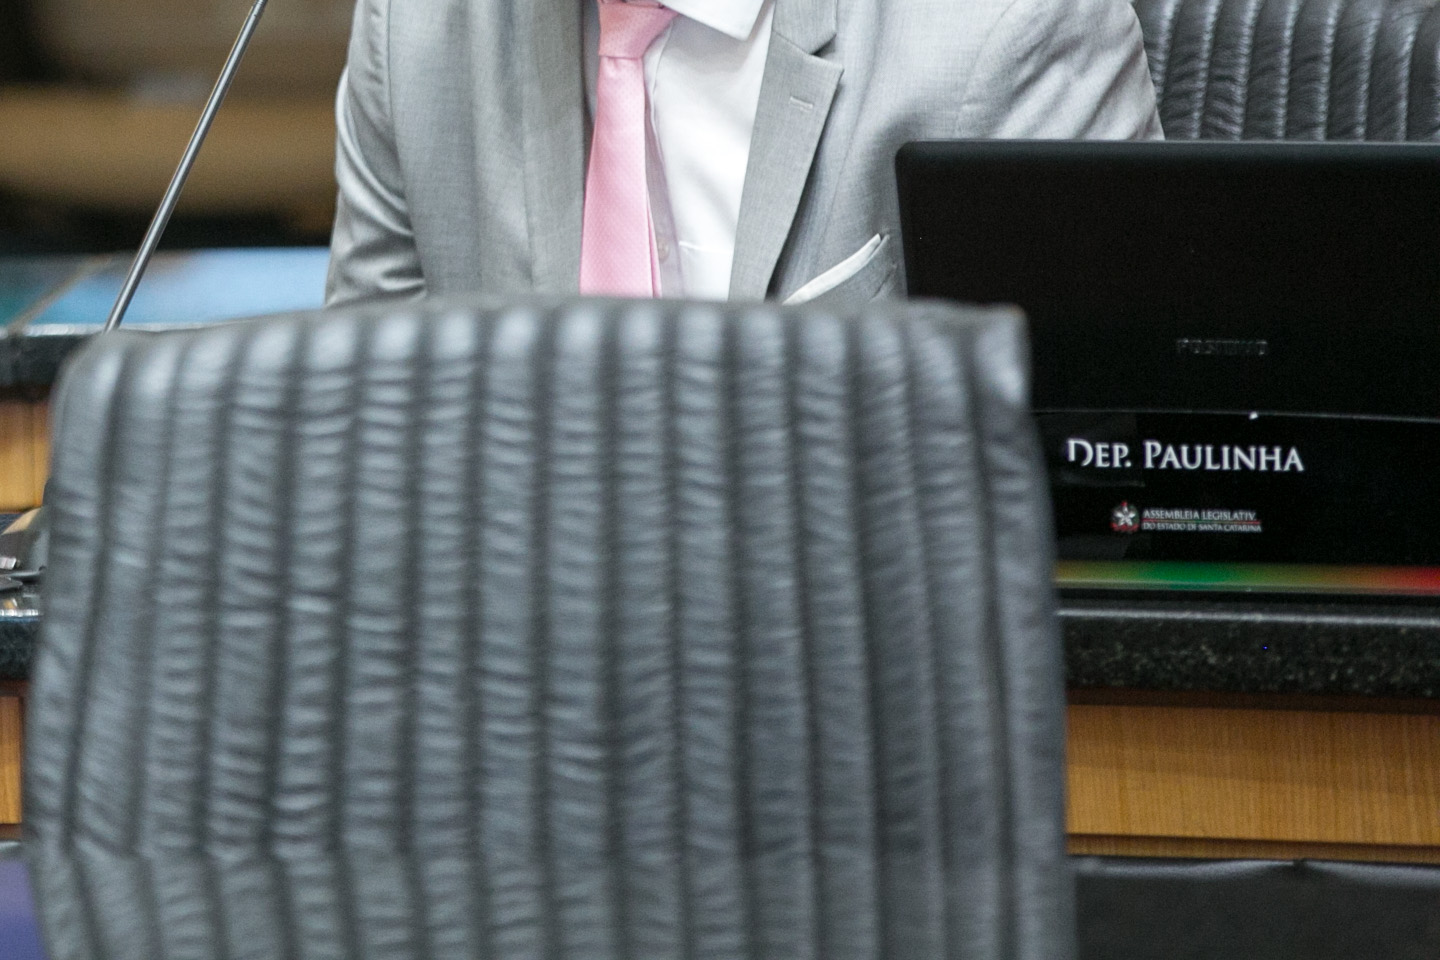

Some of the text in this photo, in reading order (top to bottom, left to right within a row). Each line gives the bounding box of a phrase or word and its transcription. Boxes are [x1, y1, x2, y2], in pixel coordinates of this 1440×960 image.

[1143, 440, 1305, 472] PAULINHA
[1143, 509, 1258, 521] ASSEMBLEIA LEGISLATIV
